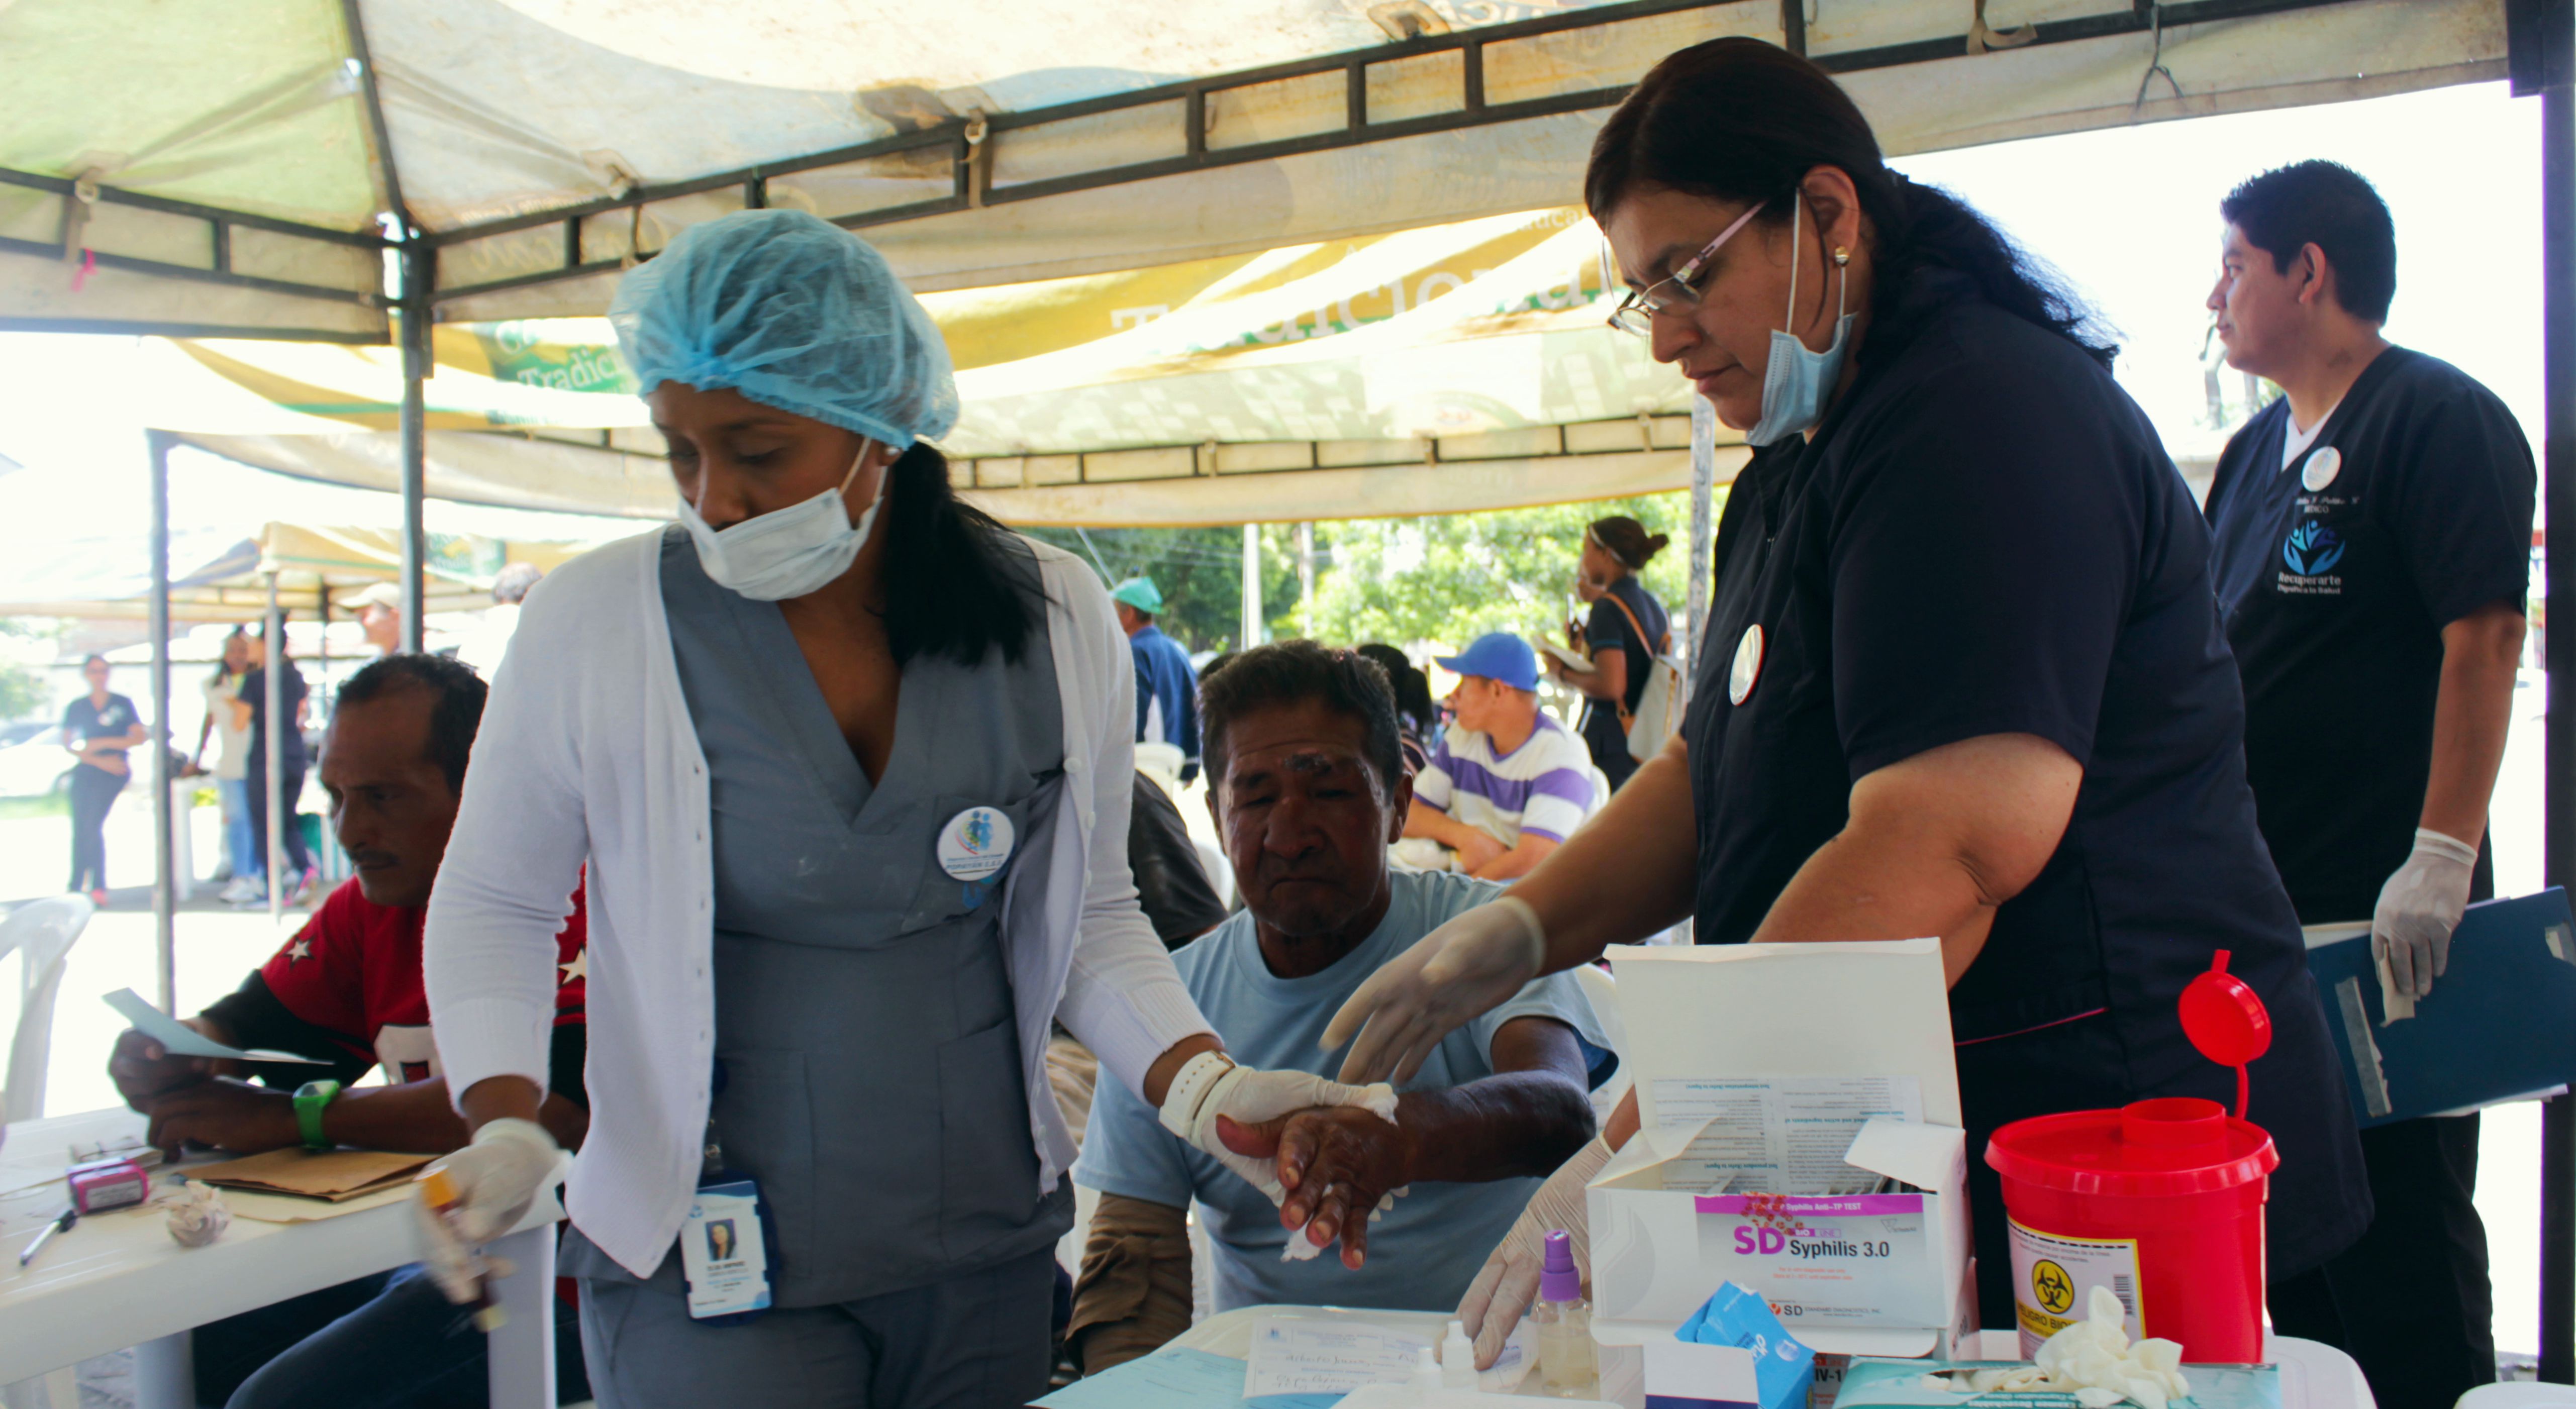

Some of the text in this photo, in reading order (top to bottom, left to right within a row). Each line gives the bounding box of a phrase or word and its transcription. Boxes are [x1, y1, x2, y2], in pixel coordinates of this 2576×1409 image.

[1786, 1202, 1813, 1212] Syphilis
[1844, 1202, 1862, 1211] TEST
[1733, 1225, 1786, 1255] SD
[1790, 1240, 1890, 1259] Syphilis 3.0
[1784, 1305, 1803, 1316] SD
